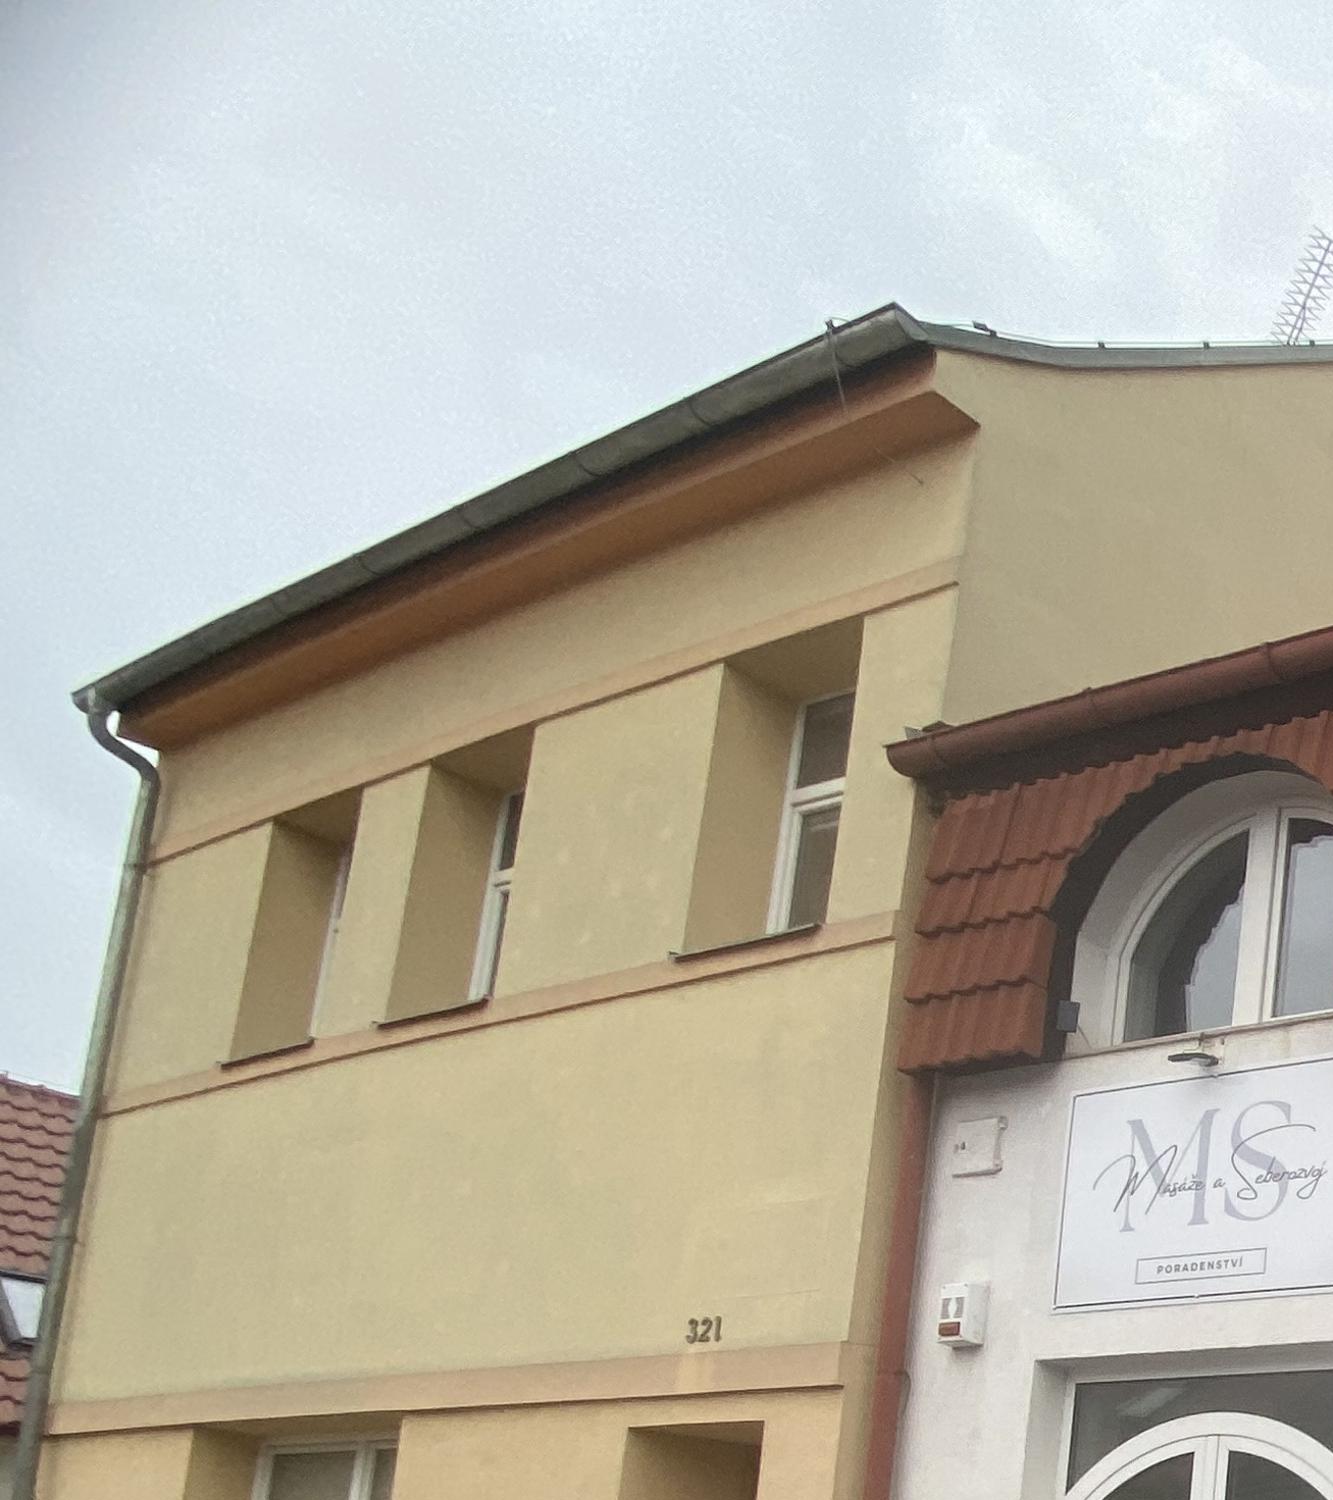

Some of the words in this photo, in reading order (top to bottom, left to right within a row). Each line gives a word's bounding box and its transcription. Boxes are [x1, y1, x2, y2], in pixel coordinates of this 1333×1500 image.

[1093, 1144, 1206, 1215] Masáže
[1213, 1178, 1226, 1189] a
[1119, 1100, 1292, 1233] MS
[1156, 1256, 1244, 1276] PORADENSTVÍ
[685, 1315, 722, 1344] 321
